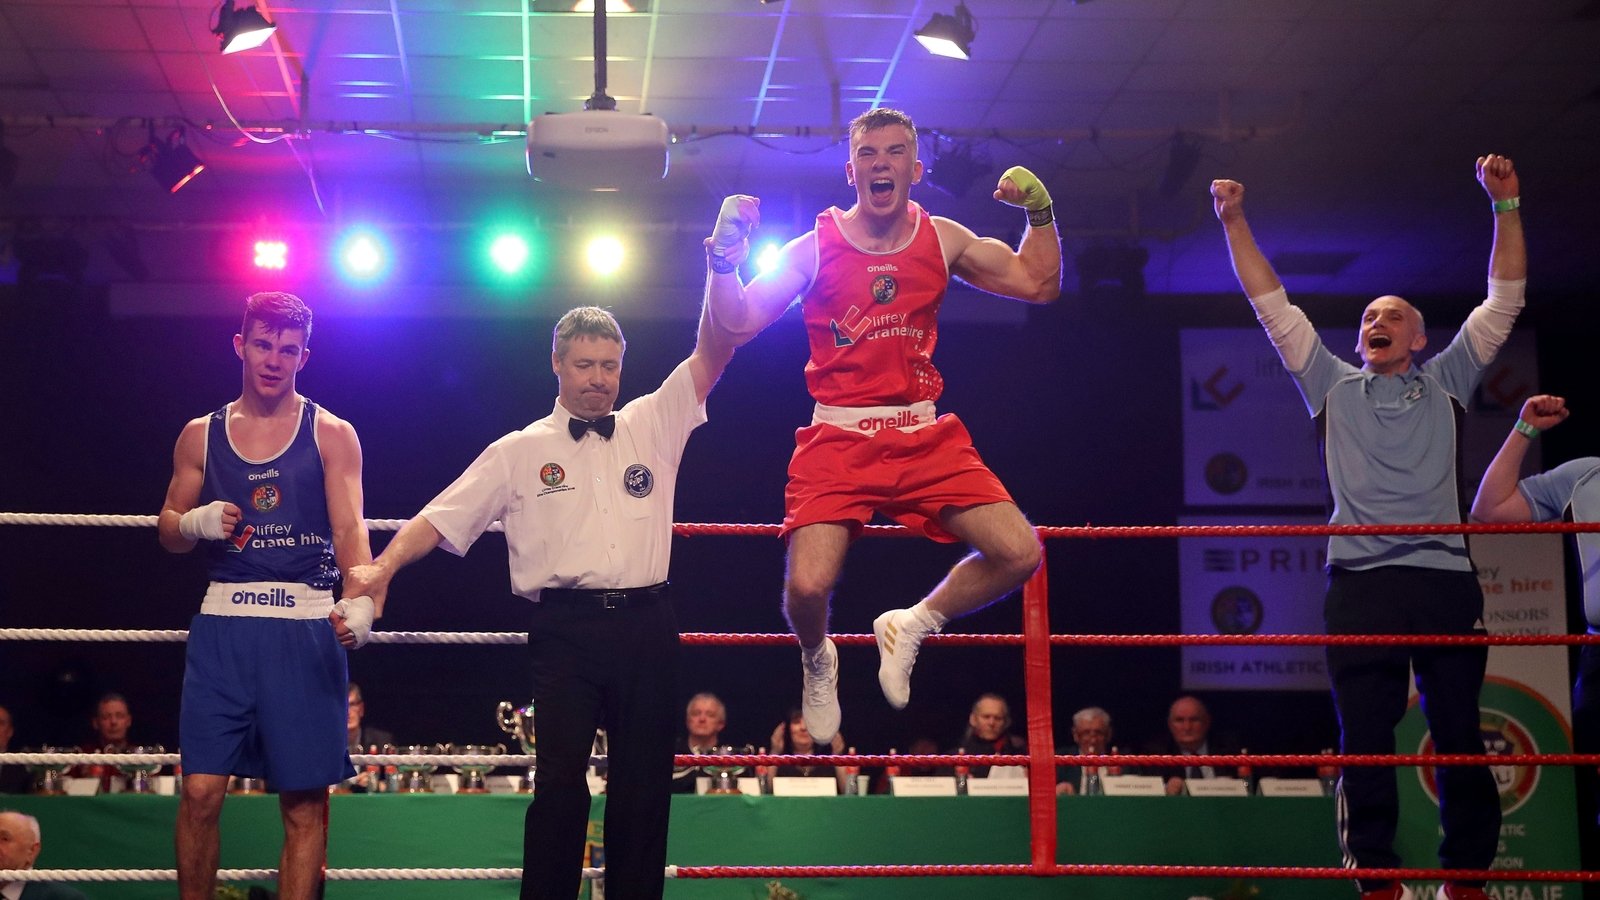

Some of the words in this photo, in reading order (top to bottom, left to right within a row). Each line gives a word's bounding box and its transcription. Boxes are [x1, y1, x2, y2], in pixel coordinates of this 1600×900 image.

[872, 312, 907, 328] liffey
[866, 326, 906, 341] crane
[256, 523, 292, 537] liffey
[252, 537, 296, 549] crane
[1511, 577, 1555, 593] hire
[1190, 660, 1235, 674] IRISH
[1240, 660, 1326, 674] ATHLETIC
